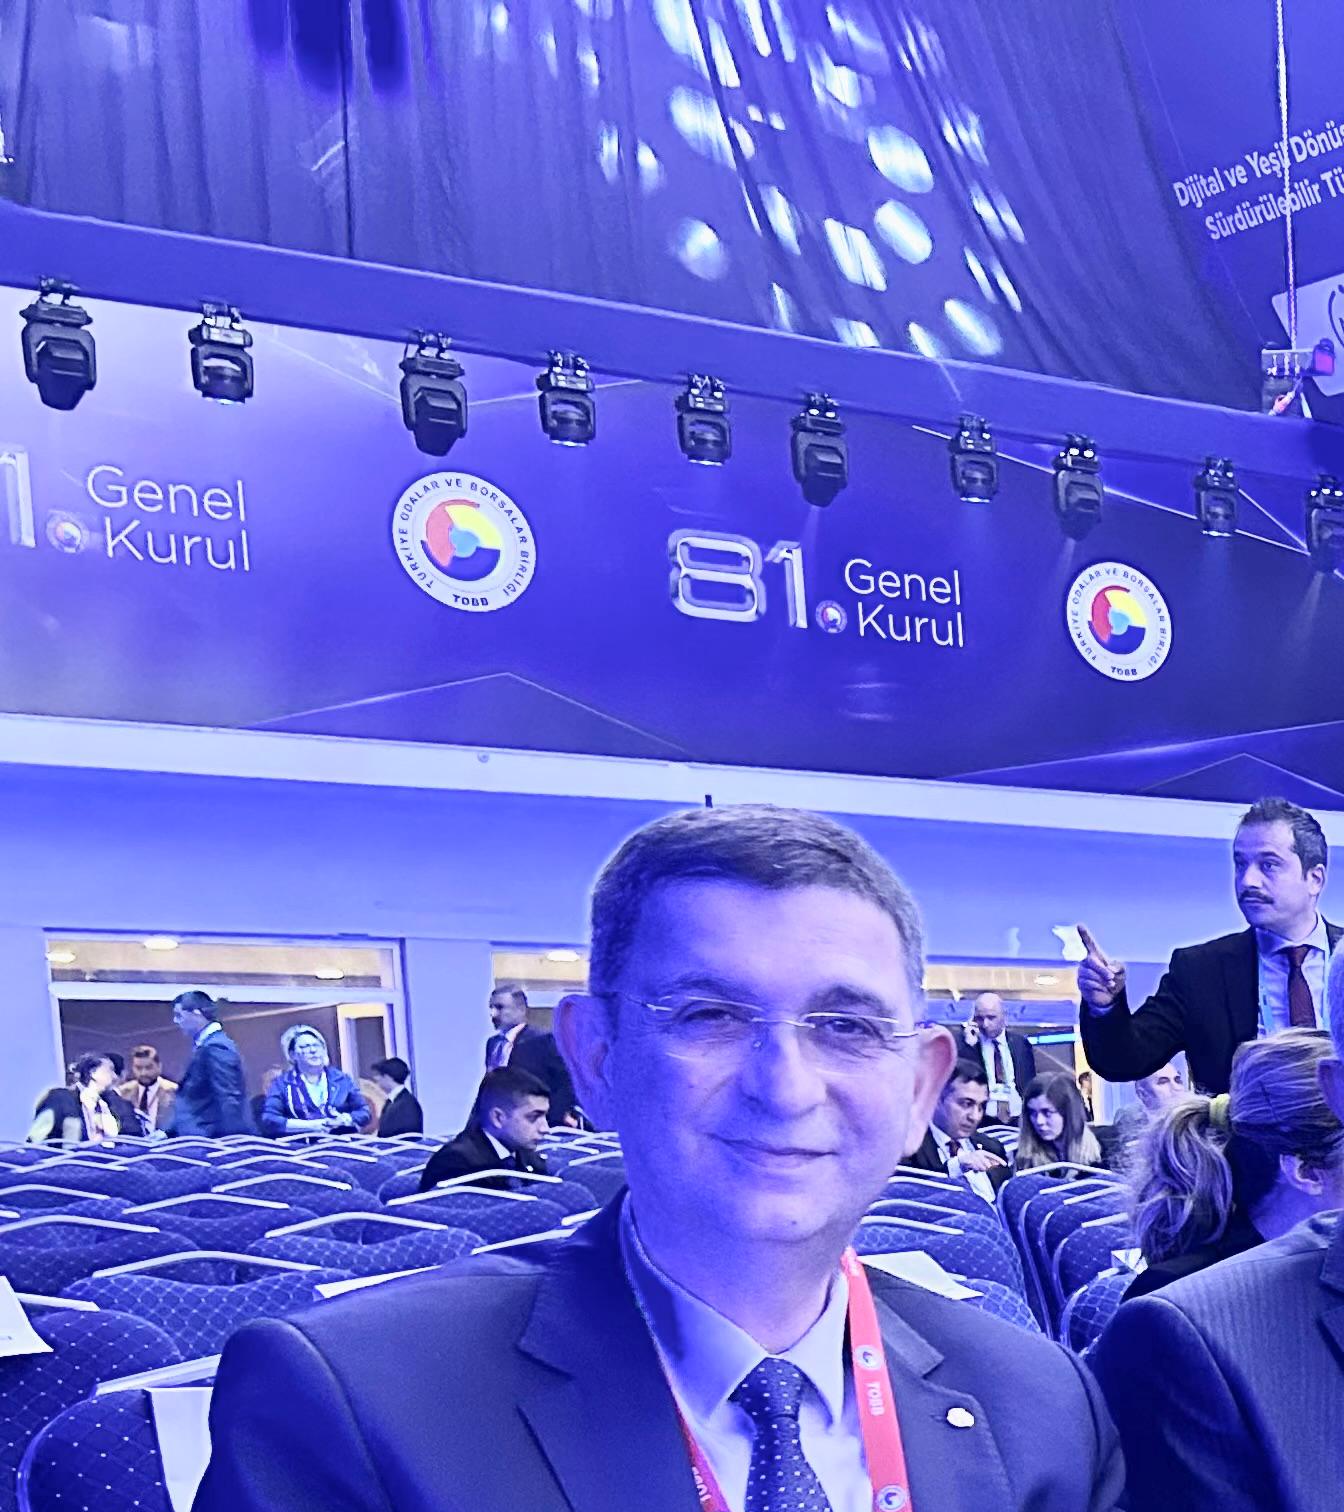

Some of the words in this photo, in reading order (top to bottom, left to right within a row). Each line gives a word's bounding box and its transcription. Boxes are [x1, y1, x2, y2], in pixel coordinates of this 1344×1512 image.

[1172, 166, 1226, 209] Dijital
[1224, 164, 1249, 188] ve
[1204, 177, 1323, 240] Sürdürülebilir
[86, 464, 247, 523] Genel
[400, 479, 441, 521] ODALAR
[444, 478, 463, 488] VE
[470, 481, 528, 545] BORSALAR
[104, 516, 250, 573] Kurul
[452, 593, 489, 607] TOBB
[844, 558, 961, 606] Genel
[857, 601, 965, 649] Kurul
